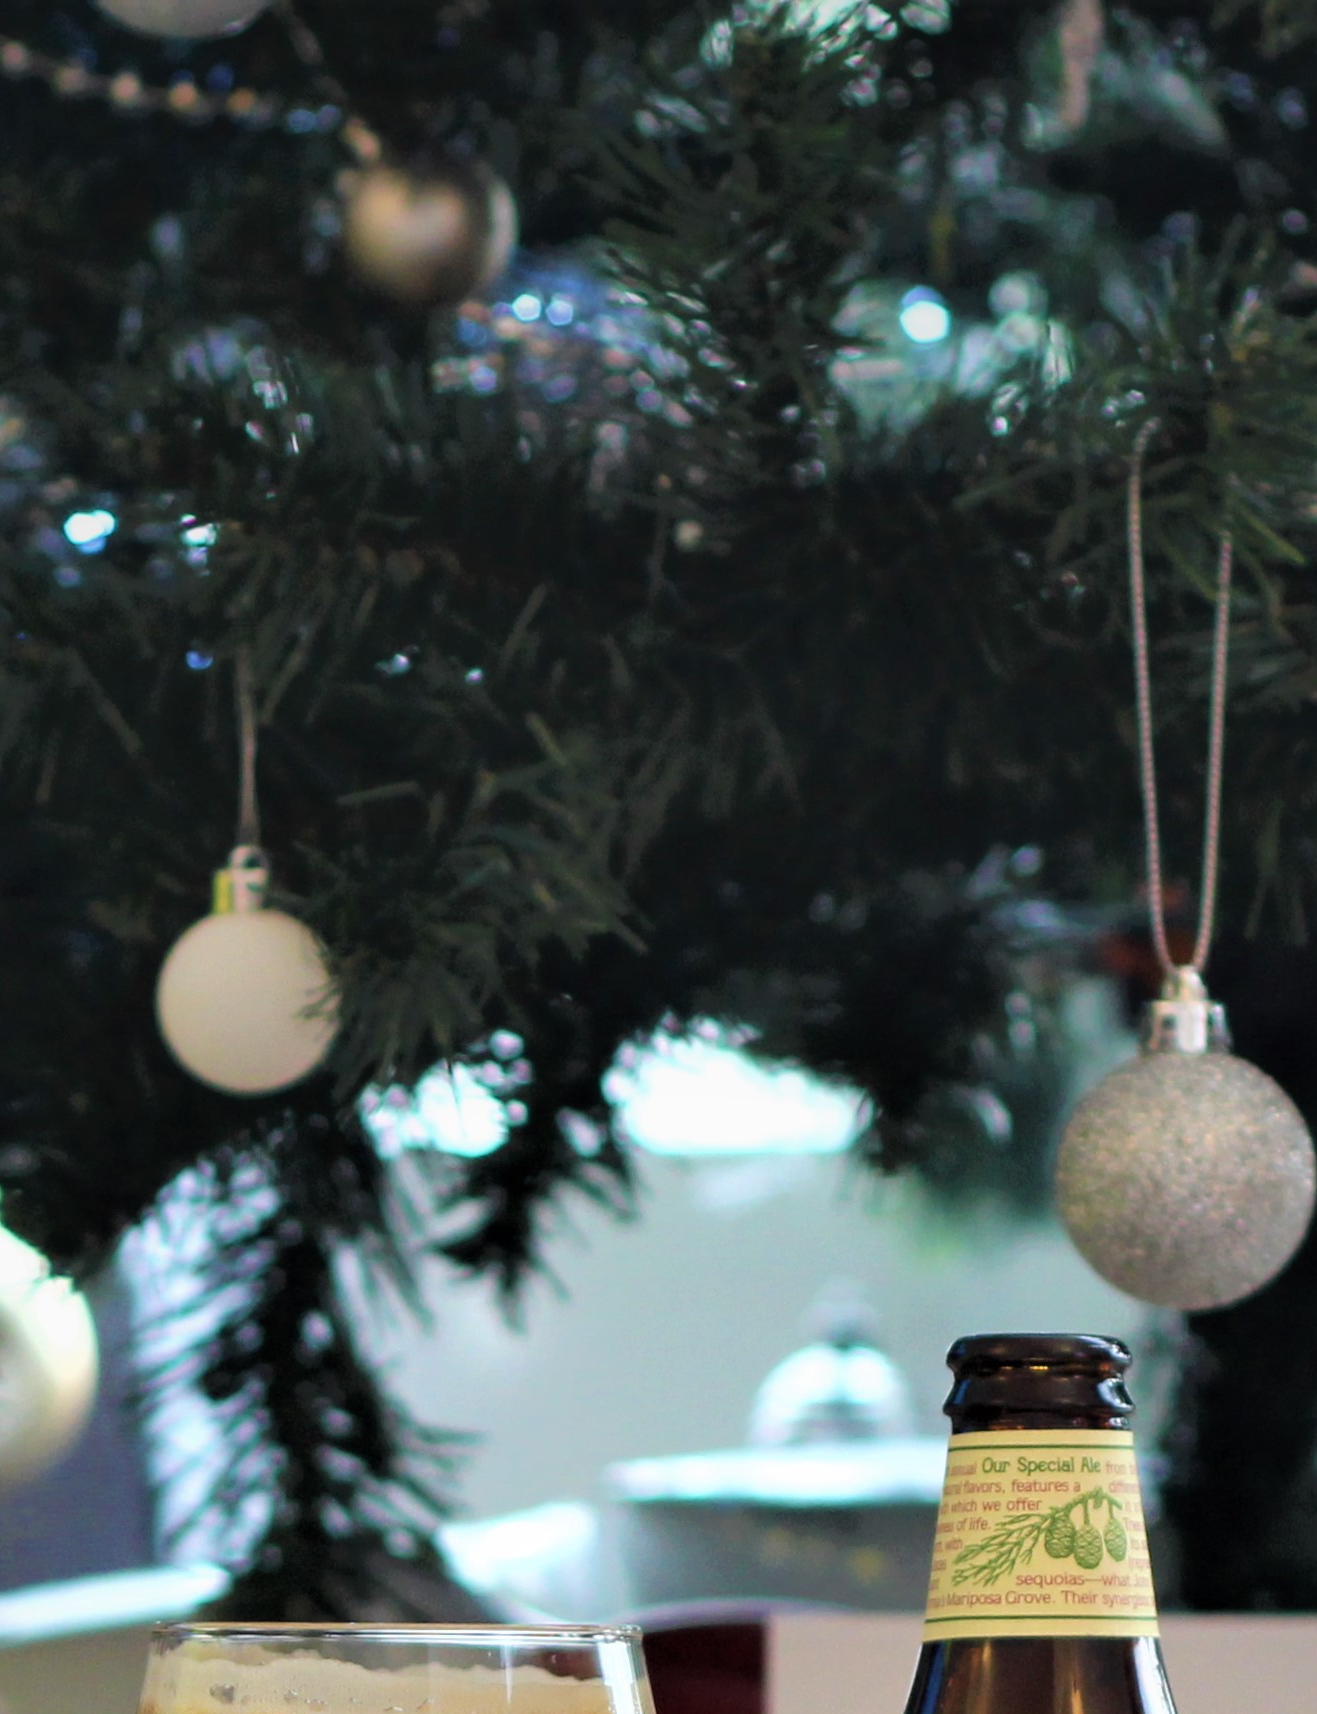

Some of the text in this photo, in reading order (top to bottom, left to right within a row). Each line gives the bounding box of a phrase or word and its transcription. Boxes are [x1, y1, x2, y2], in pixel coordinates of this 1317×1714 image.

[982, 1457, 1011, 1473] Our
[1017, 1456, 1074, 1476] Special
[1081, 1457, 1101, 1473] Ale
[963, 1480, 1006, 1494] flavors,
[1012, 1478, 1069, 1493] features
[1074, 1481, 1081, 1492] a
[983, 1500, 1001, 1511] we
[1006, 1497, 1042, 1512] offer
[969, 1516, 992, 1531] life.
[946, 1590, 1002, 1608] Mariposa
[1005, 1590, 1056, 1605] Grove.
[1061, 1590, 1098, 1604] Their
